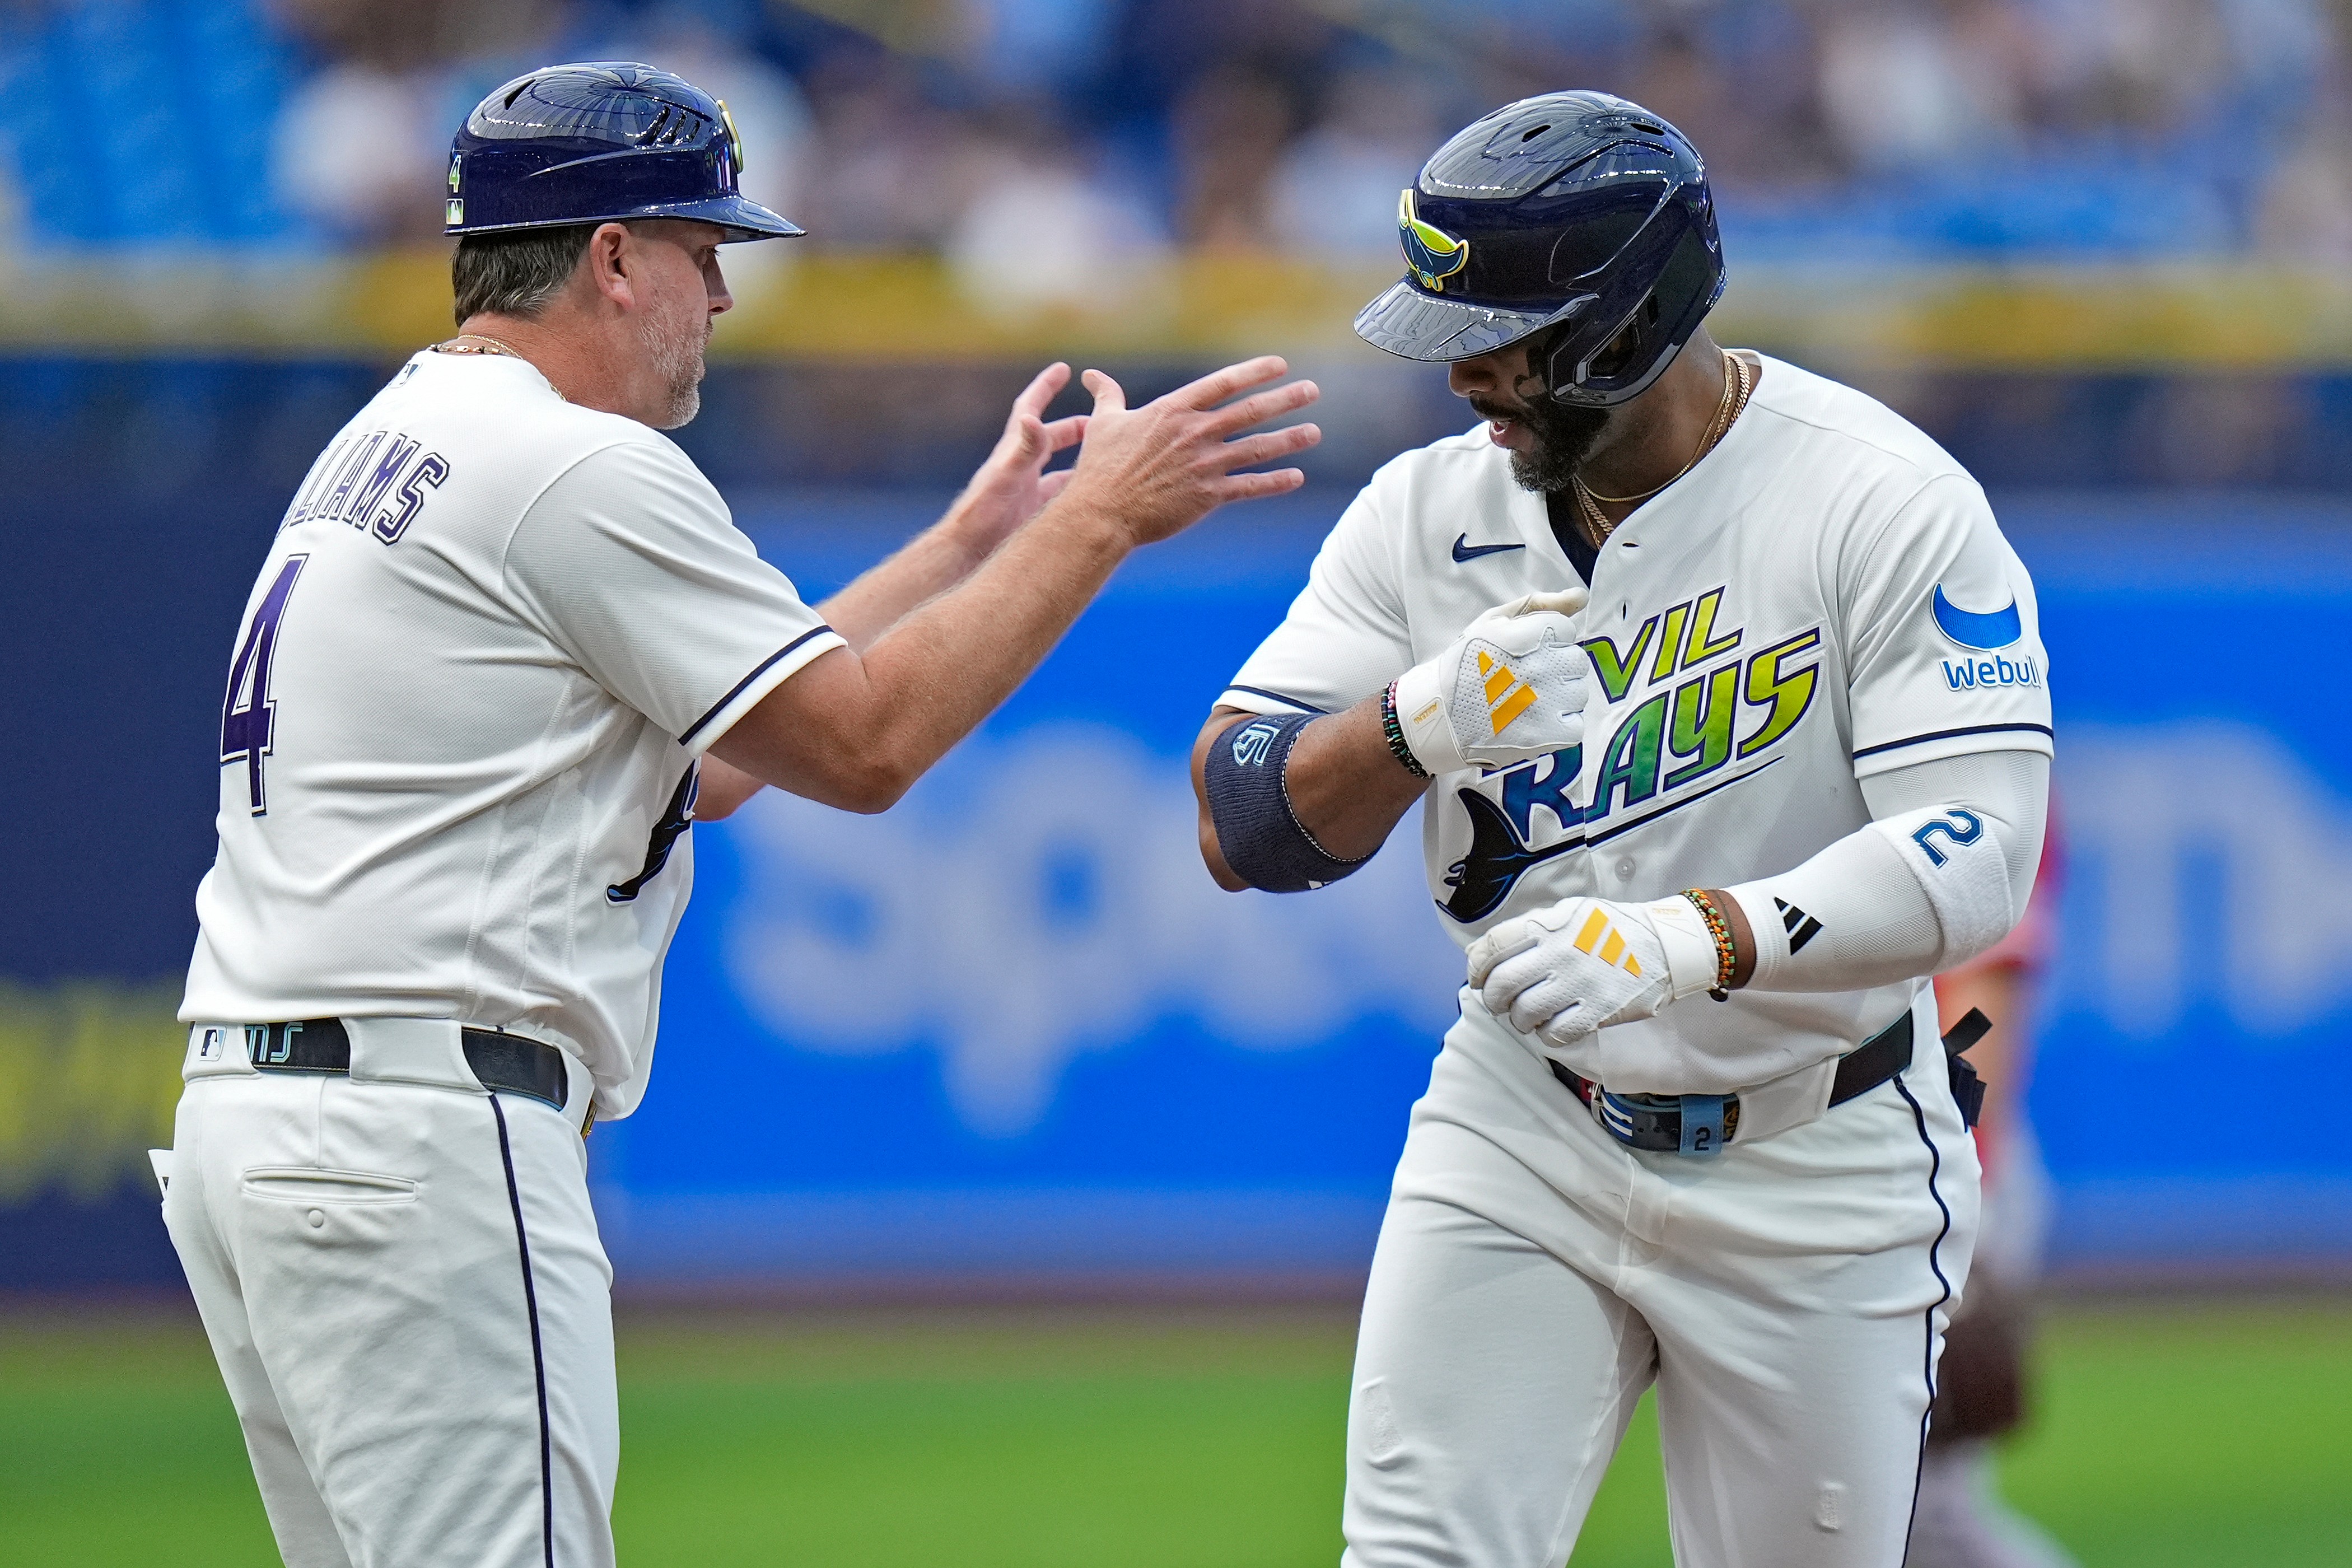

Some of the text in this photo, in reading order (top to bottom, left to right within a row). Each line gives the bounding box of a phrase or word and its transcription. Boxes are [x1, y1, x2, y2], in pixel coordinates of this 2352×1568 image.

[449, 155, 461, 193] 4
[1575, 585, 1744, 704] VIL
[220, 553, 310, 817] 4
[1910, 808, 1984, 869] 2
[1694, 1126, 1711, 1152] 2
